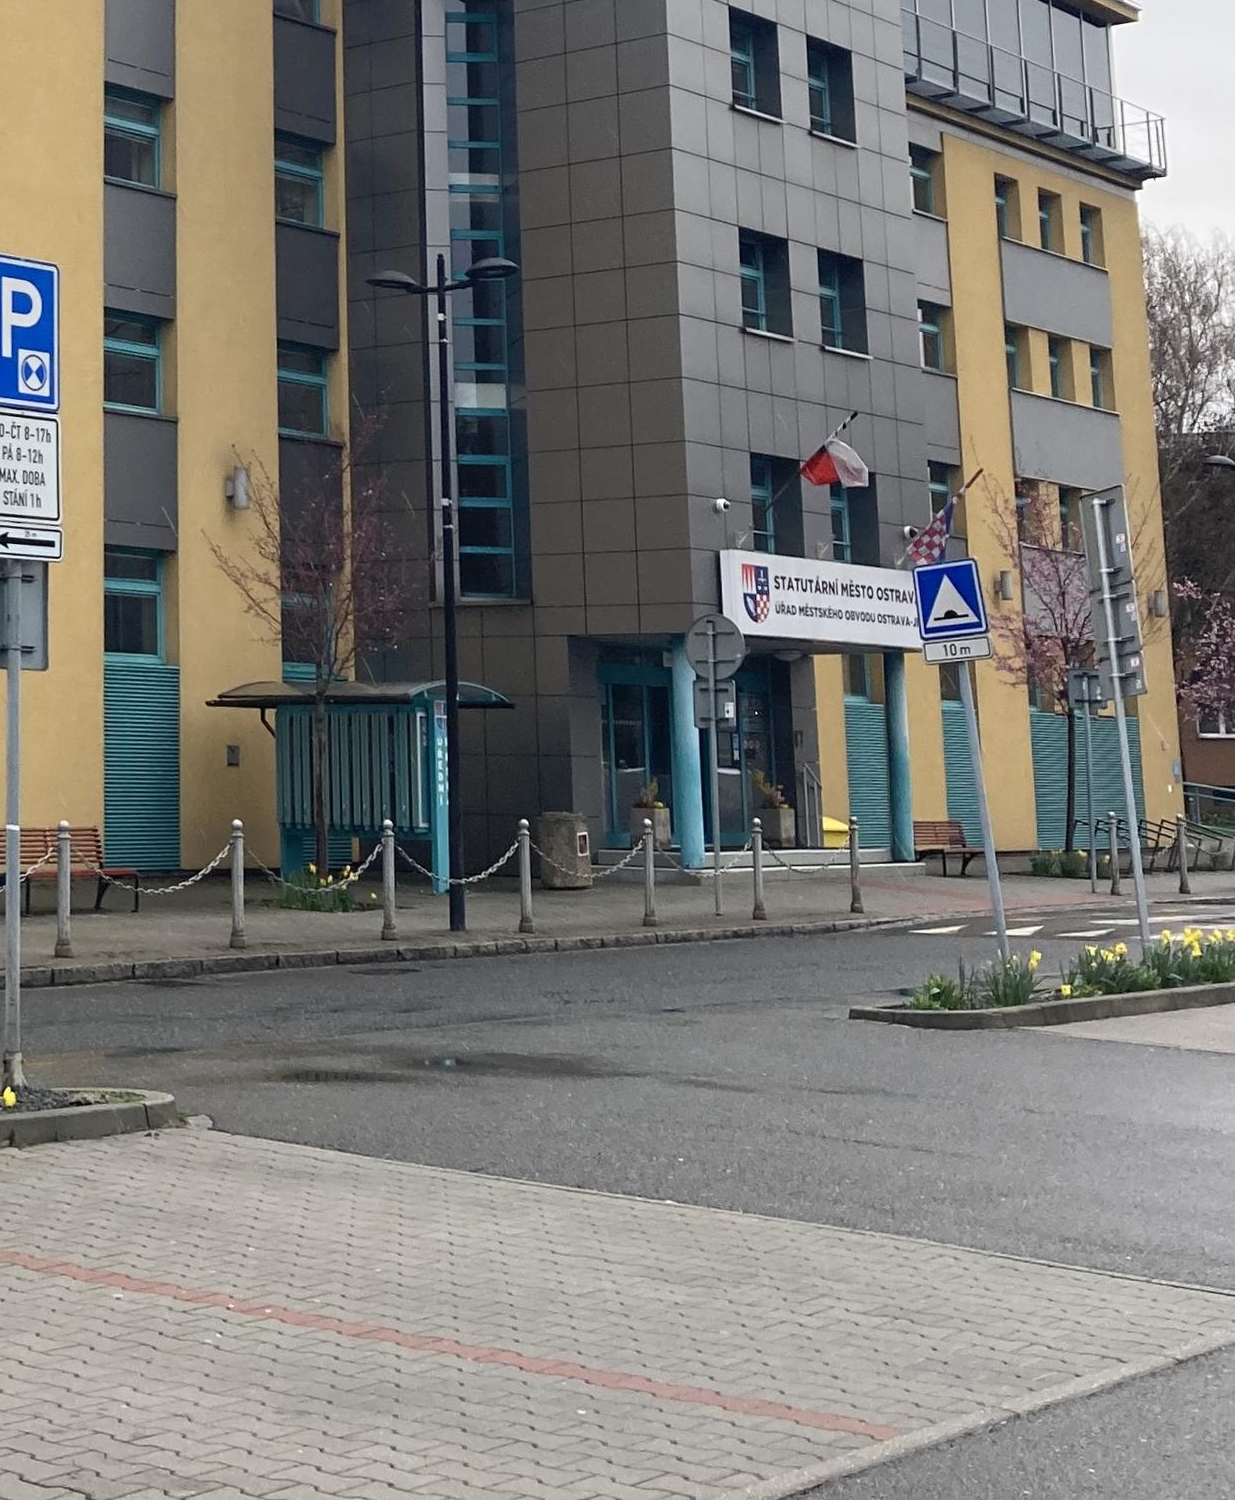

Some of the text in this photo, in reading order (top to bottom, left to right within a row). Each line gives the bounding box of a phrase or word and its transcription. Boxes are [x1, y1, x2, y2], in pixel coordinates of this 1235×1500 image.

[1, 276, 43, 358] P
[24, 426, 52, 443] 8-17h
[2, 442, 44, 464] PÁ 8-12h
[22, 470, 46, 486] DOBA
[3, 488, 28, 507] STÁNÍ
[774, 575, 917, 604] STATUTÁRNÍ MĚSTO OSTRAV
[775, 600, 919, 628] ÚŘAD MĚSTSKÉHO OBVODU OSTRAVA-J
[943, 643, 971, 656] 10 m
